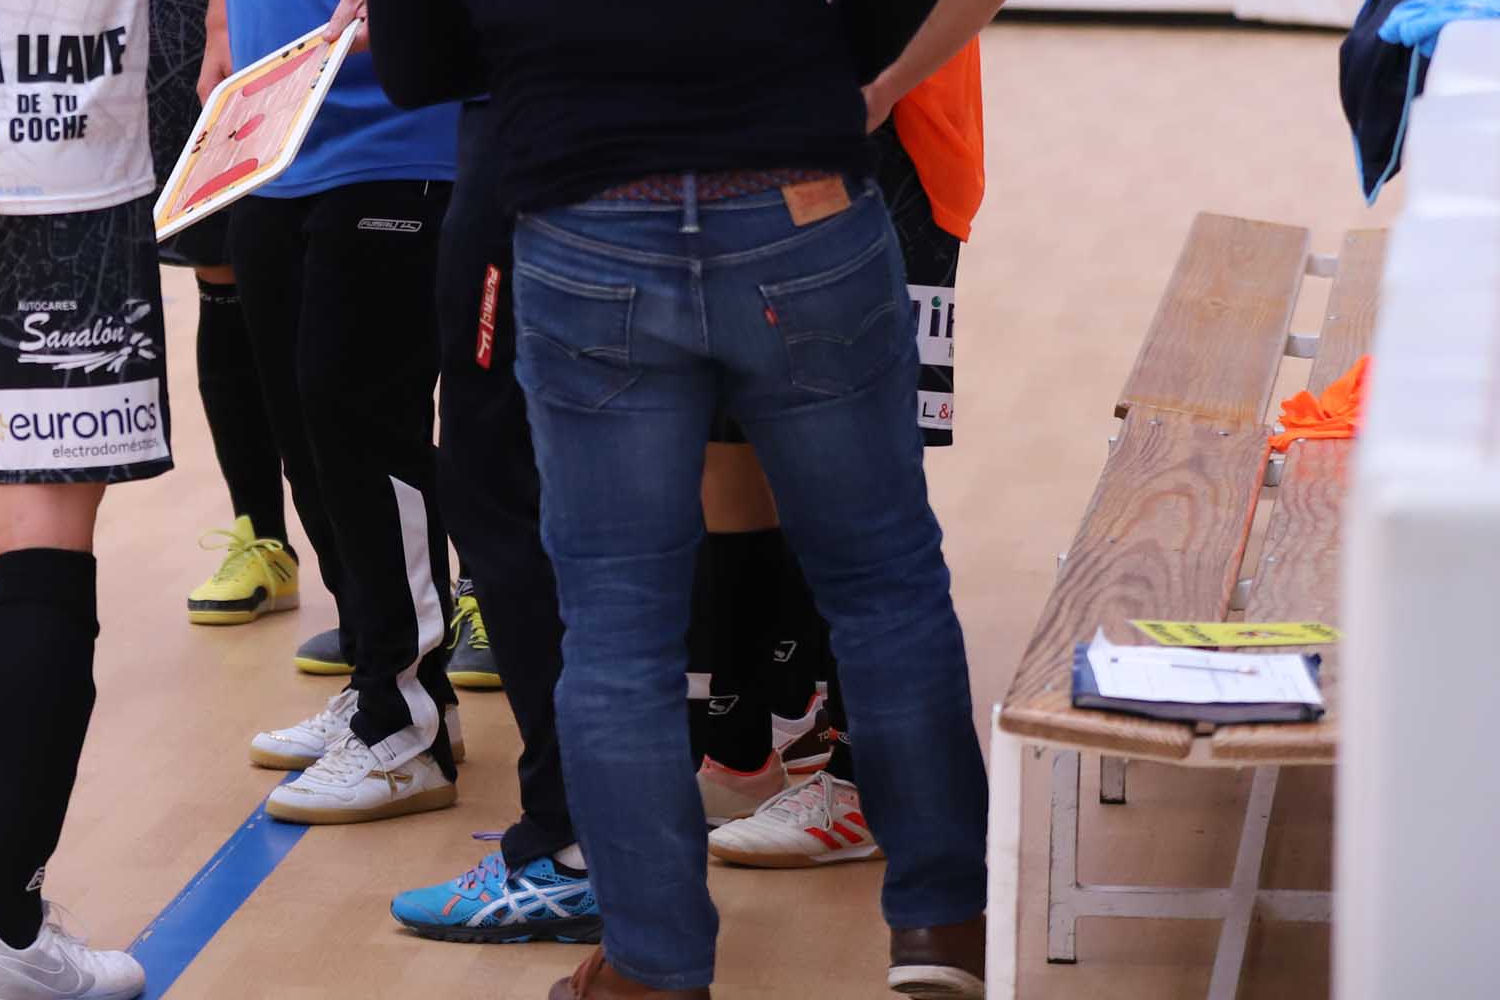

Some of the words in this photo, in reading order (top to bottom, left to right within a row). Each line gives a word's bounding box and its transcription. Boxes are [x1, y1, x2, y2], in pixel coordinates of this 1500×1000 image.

[17, 93, 41, 115] DE
[52, 94, 77, 115] TU
[9, 114, 88, 143] COCHE
[17, 301, 77, 312] AUTOCARES
[19, 312, 125, 351] Sanalón
[9, 398, 157, 441] euronics
